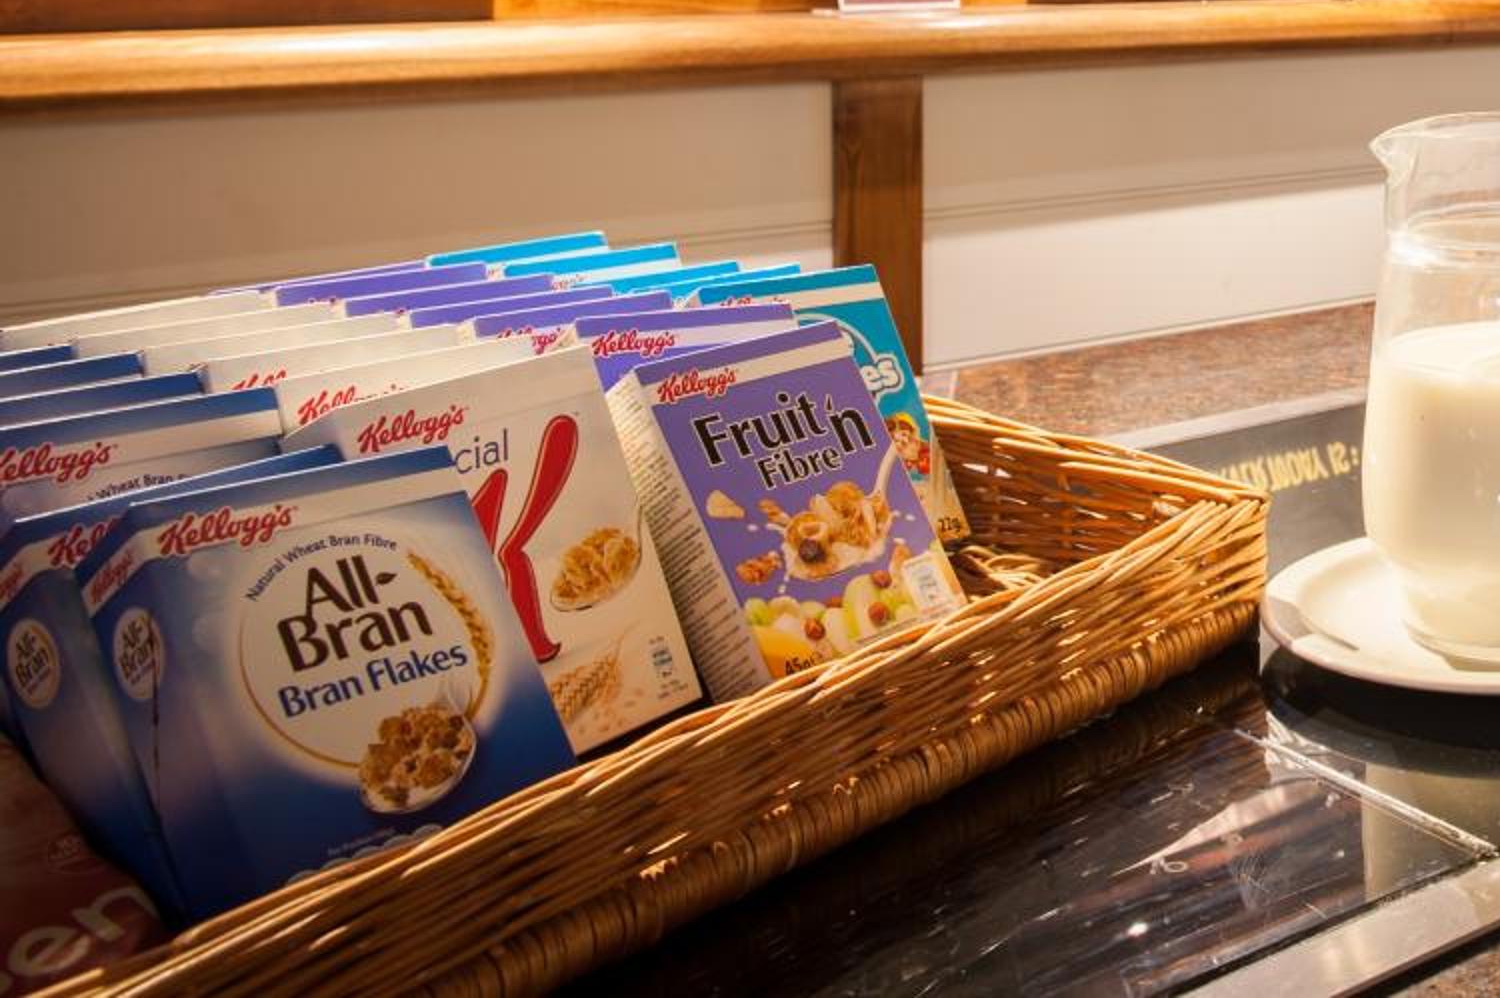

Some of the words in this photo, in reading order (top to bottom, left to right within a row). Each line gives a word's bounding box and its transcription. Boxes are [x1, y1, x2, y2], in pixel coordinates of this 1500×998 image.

[592, 330, 676, 358] Kellogg's
[657, 367, 737, 403] Kellogg's
[358, 405, 466, 453] Kellogg's
[692, 392, 826, 467] Fruit
[0, 442, 112, 483] ellogg's
[758, 448, 840, 489] Fibre
[158, 505, 294, 554] Kellogg's
[246, 558, 285, 601] Natural
[284, 540, 326, 564] Wheat
[328, 535, 361, 547] Bran
[364, 533, 398, 551] Fibre
[277, 601, 433, 672] Bran
[278, 675, 365, 718] Bran
[366, 645, 468, 692] Flakes
